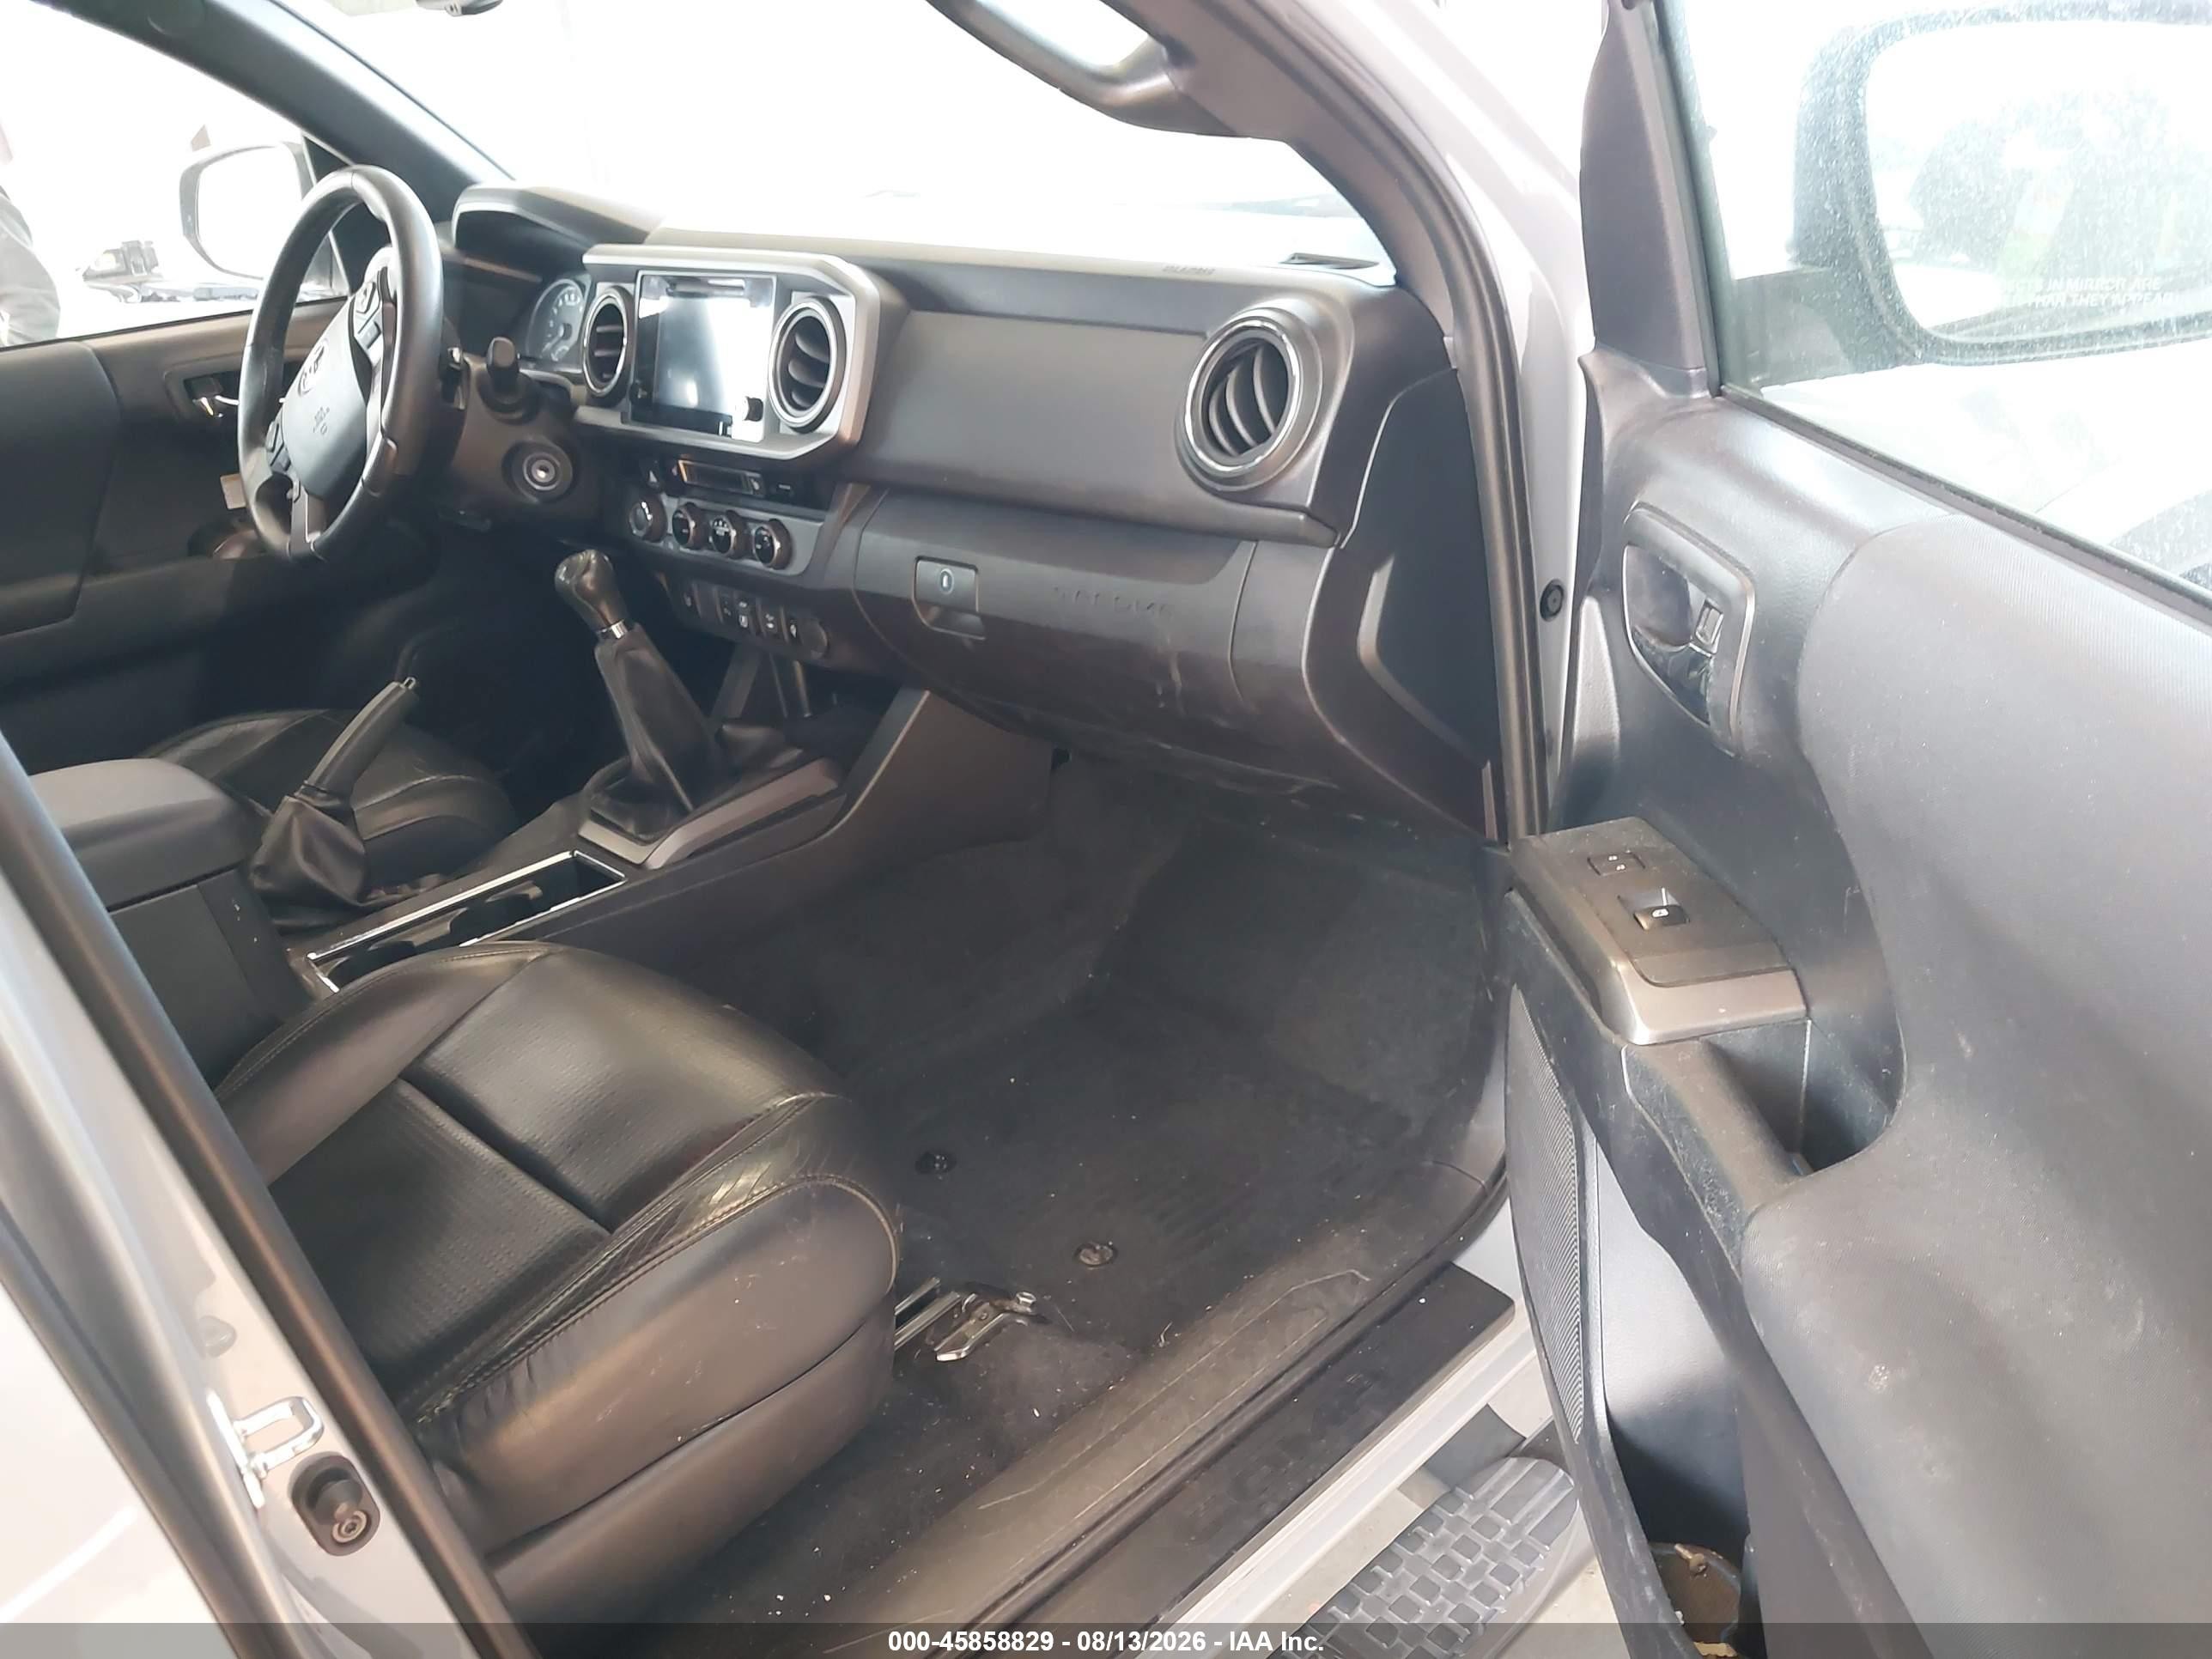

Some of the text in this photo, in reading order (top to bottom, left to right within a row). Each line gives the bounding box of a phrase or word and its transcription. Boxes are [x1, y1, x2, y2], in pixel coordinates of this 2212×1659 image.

[2046, 277, 2066, 292] IN
[2067, 276, 2127, 292] MIRROR
[2128, 276, 2163, 292] ARE
[2070, 293, 2108, 307] THEY
